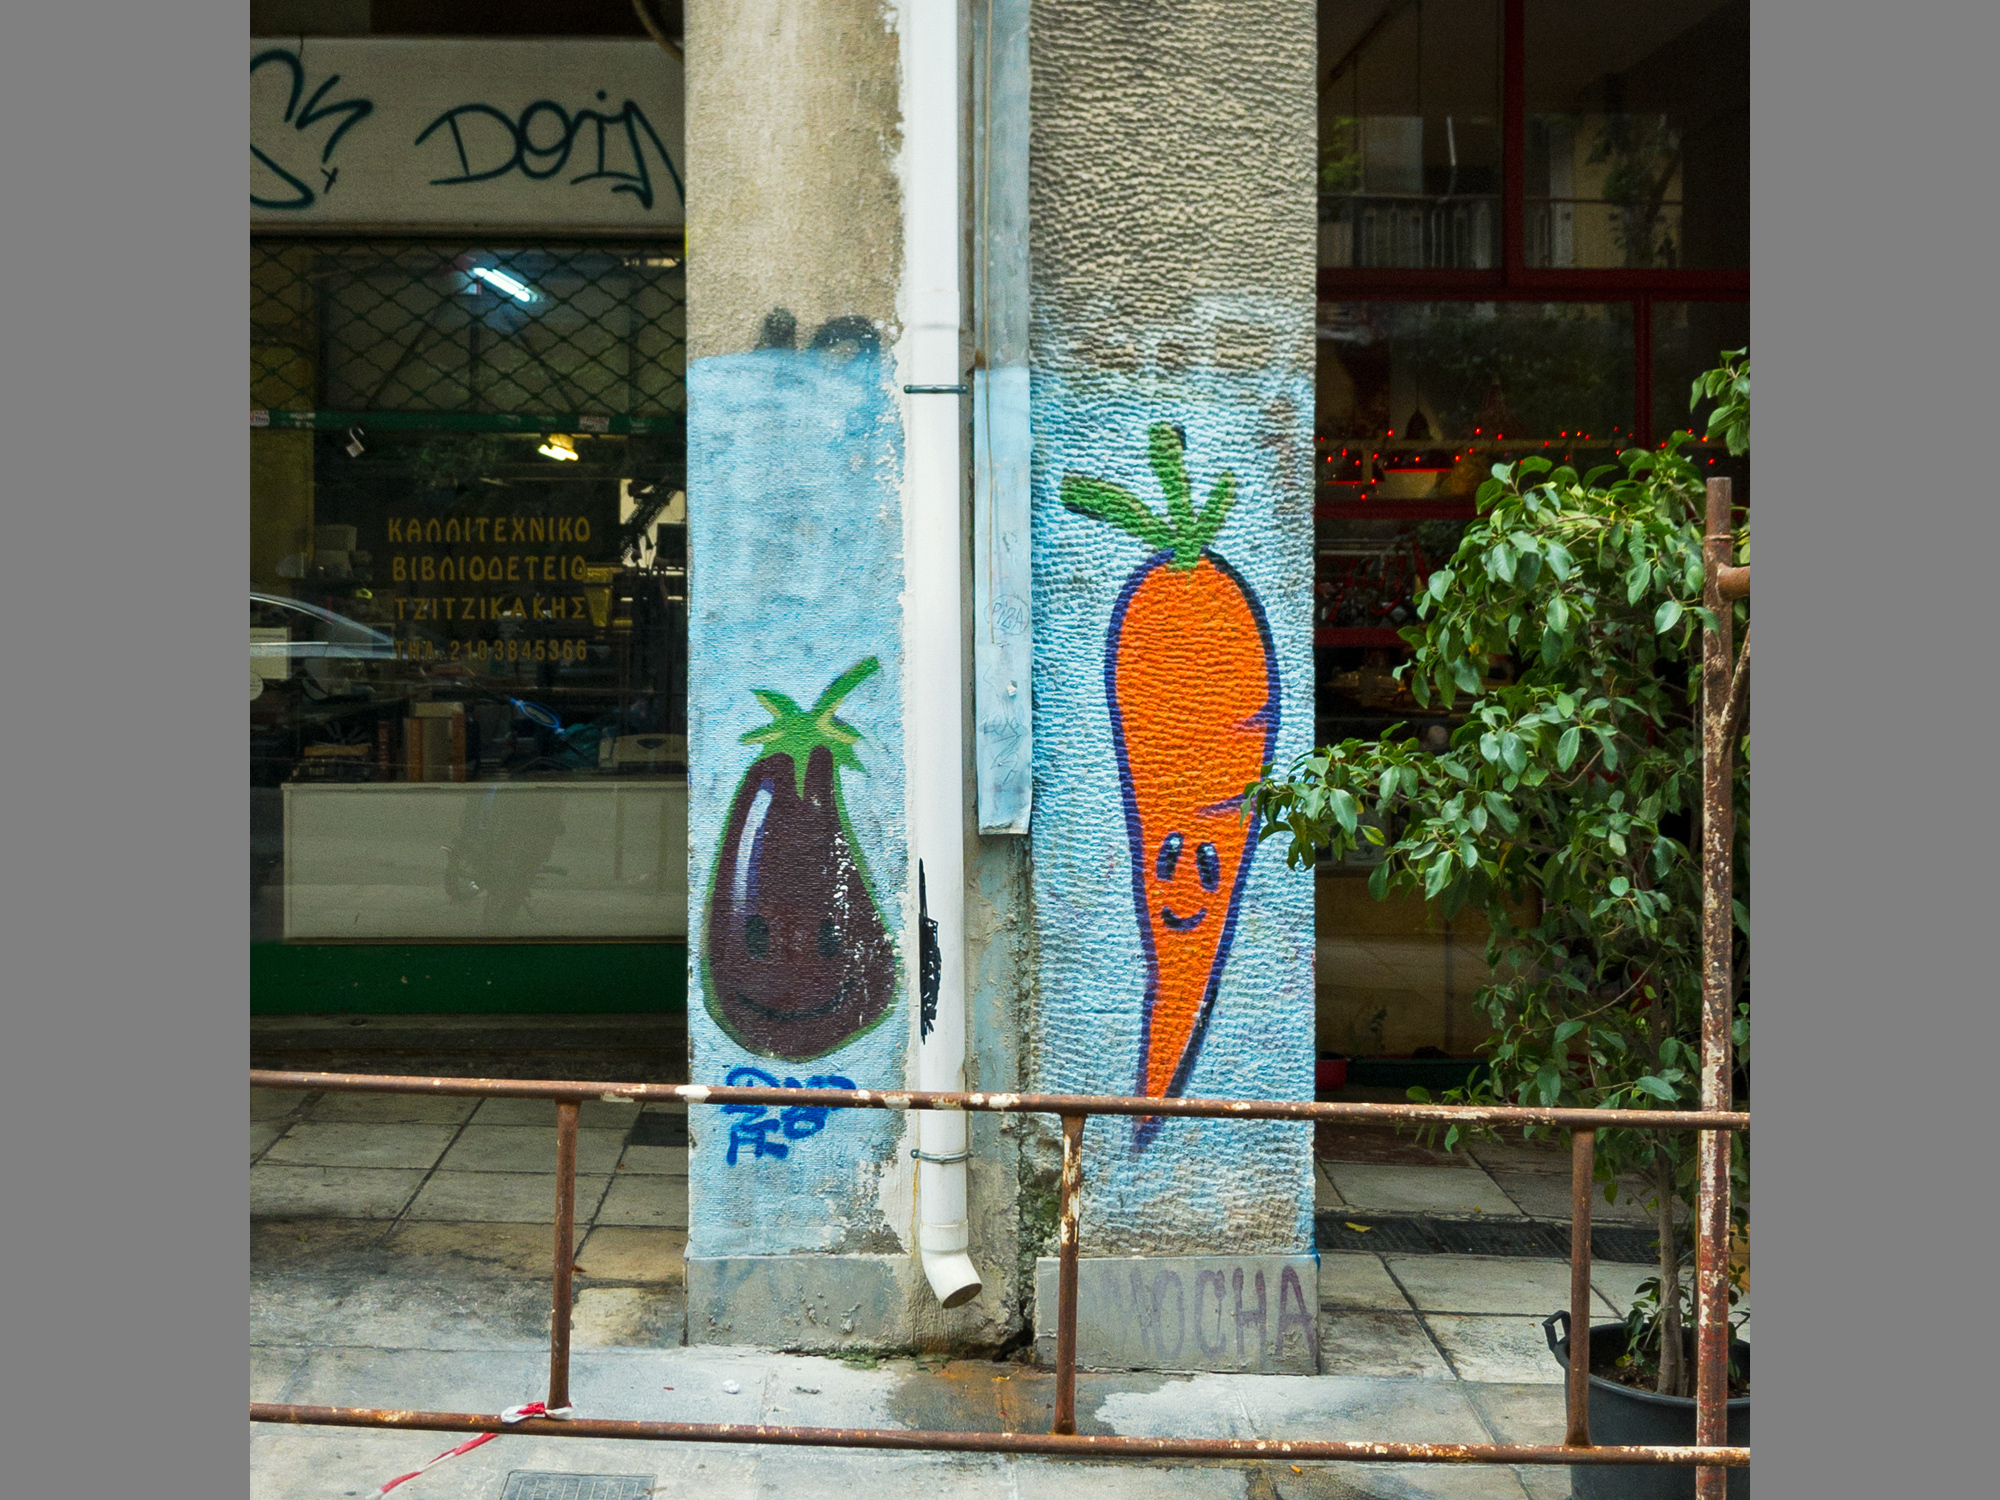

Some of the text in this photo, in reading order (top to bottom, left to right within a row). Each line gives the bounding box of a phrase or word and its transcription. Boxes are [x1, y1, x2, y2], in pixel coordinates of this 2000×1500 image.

[388, 517, 592, 542] ΚΑΛΛΙΤΕΧΝΙΚΟ
[392, 555, 588, 581] ΒΙΒΛΙΟΔΕΤΕΙΟ
[394, 597, 586, 620] ΤΖΙΤΖΙΚΑΚΗΣ
